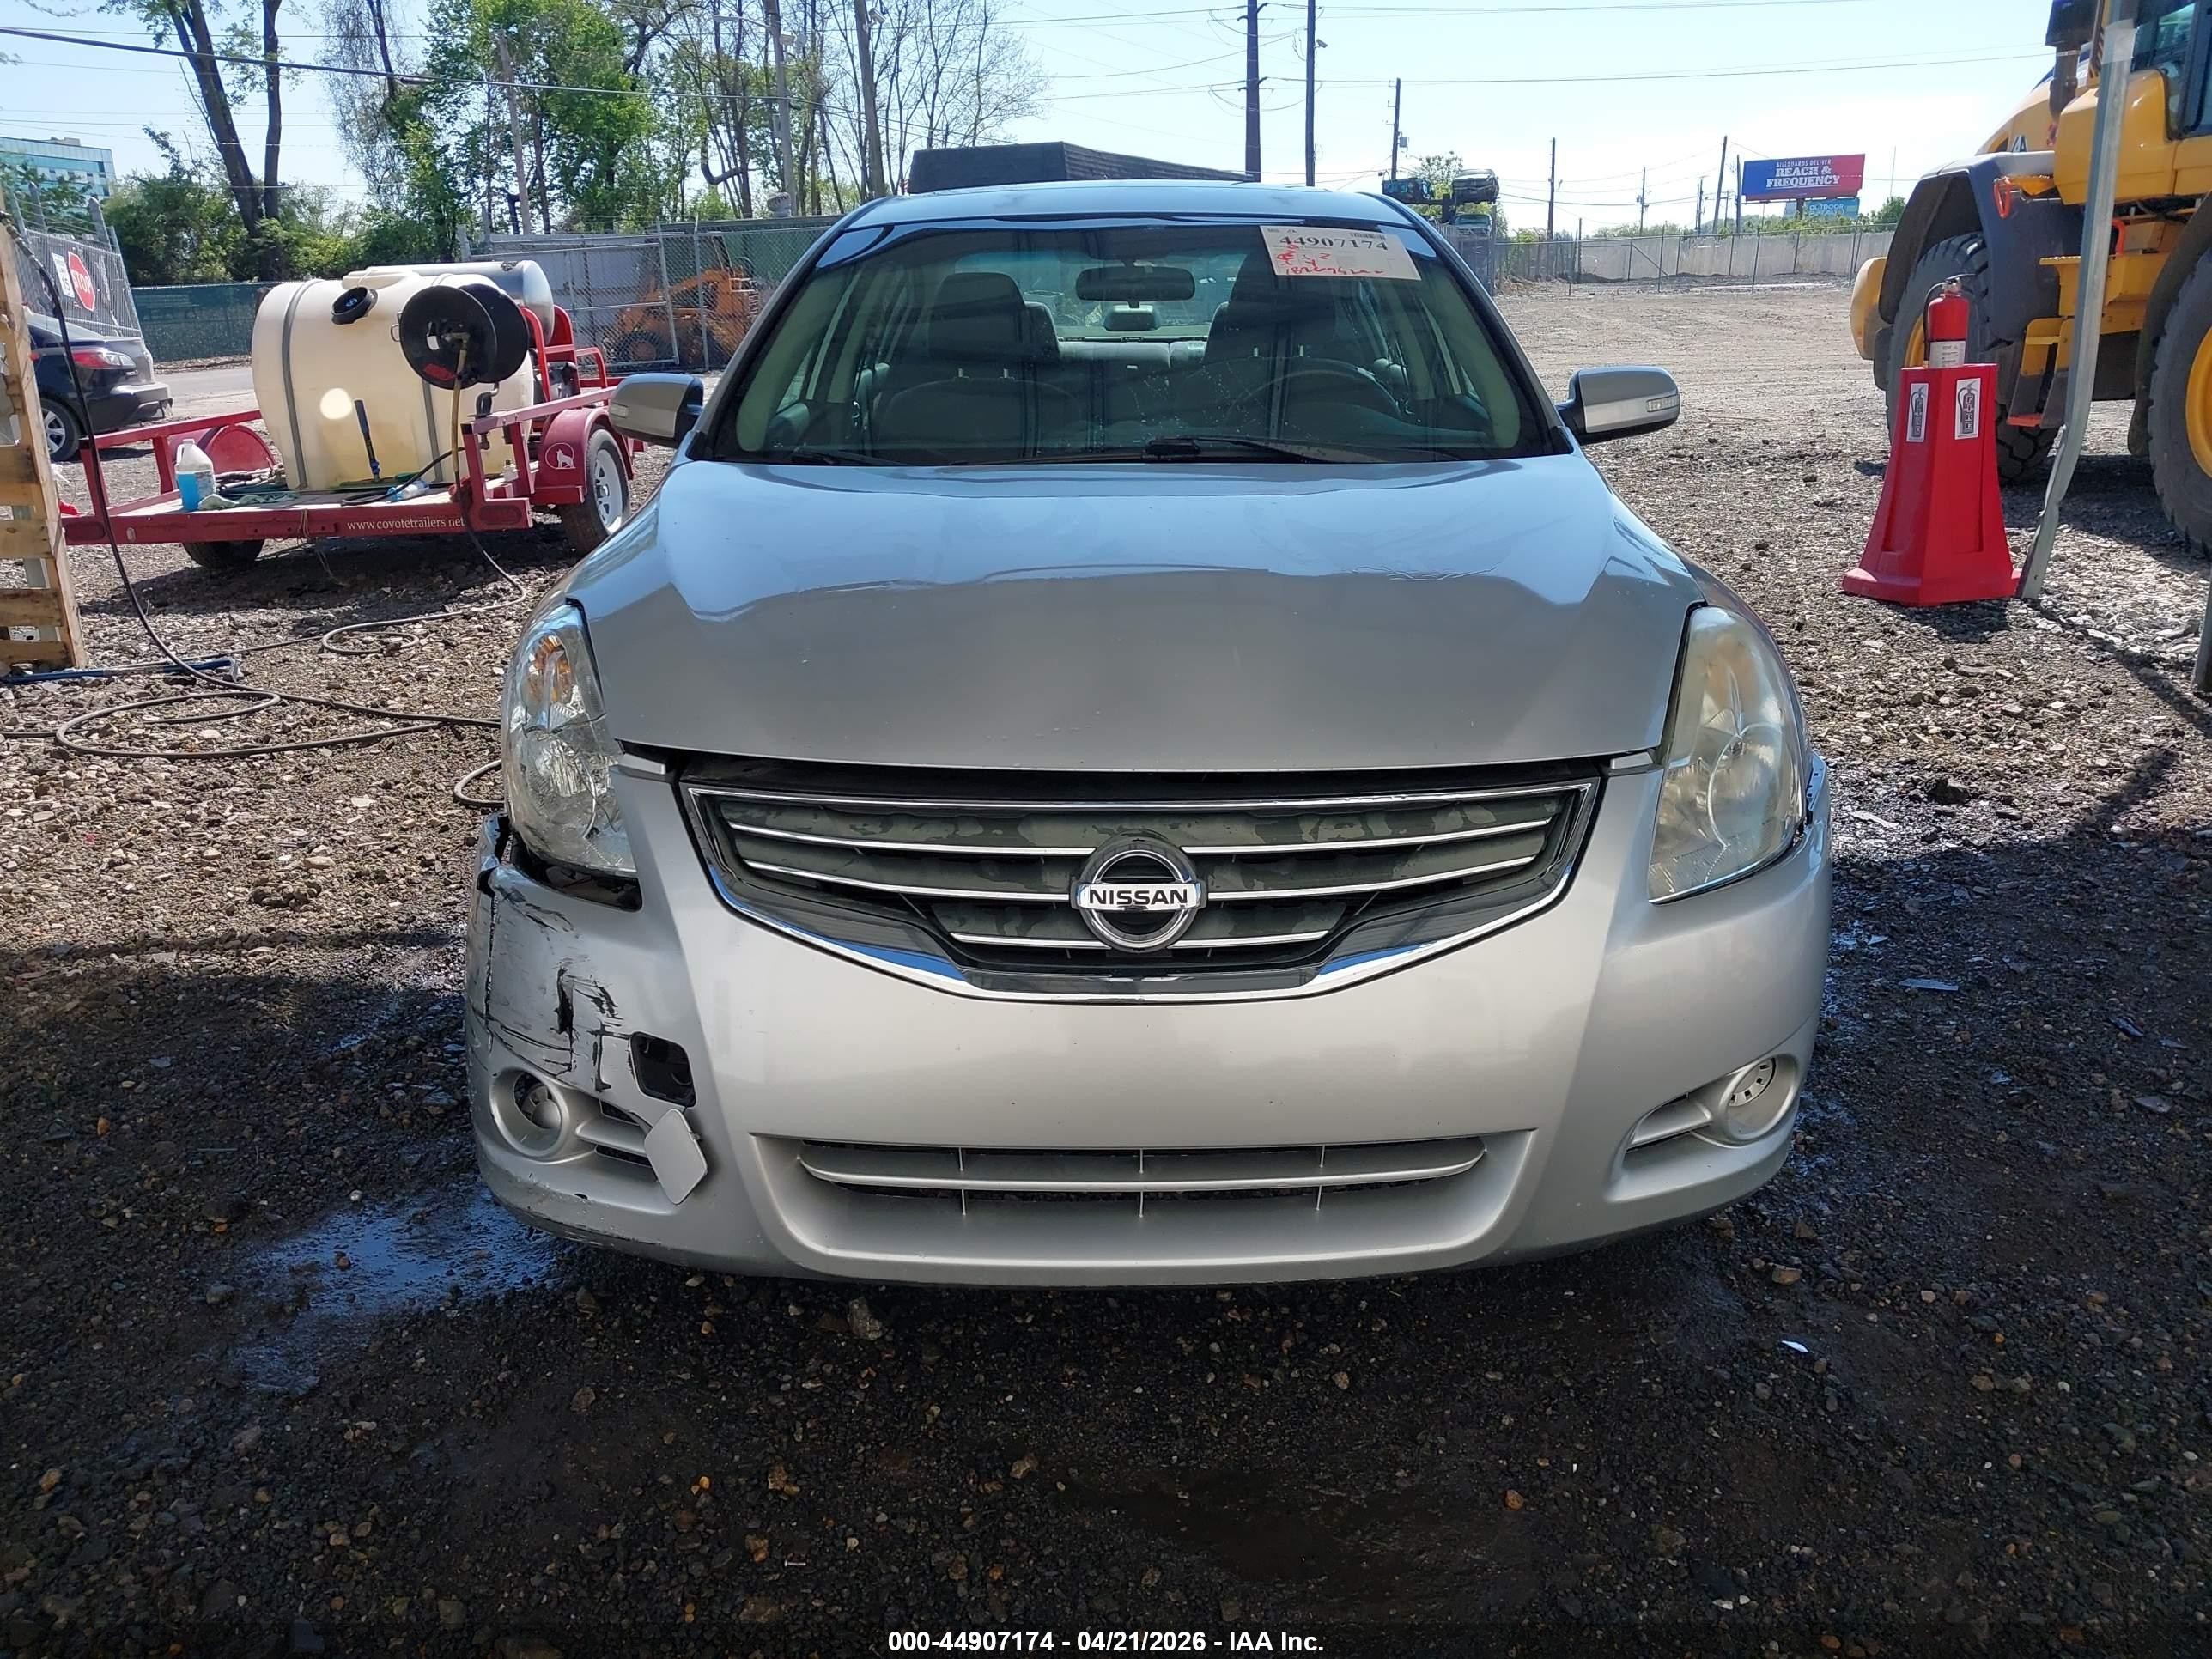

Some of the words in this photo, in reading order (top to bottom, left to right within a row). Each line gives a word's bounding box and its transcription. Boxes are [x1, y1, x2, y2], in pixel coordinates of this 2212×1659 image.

[1775, 166, 1819, 177] REACH
[1821, 166, 1832, 174] &
[1766, 175, 1840, 187] FREQUENCY
[1279, 236, 1389, 251] 44907174
[70, 269, 92, 294] STOP
[1964, 396, 1974, 430] FIRE
[1089, 889, 1188, 905] NISSAN
